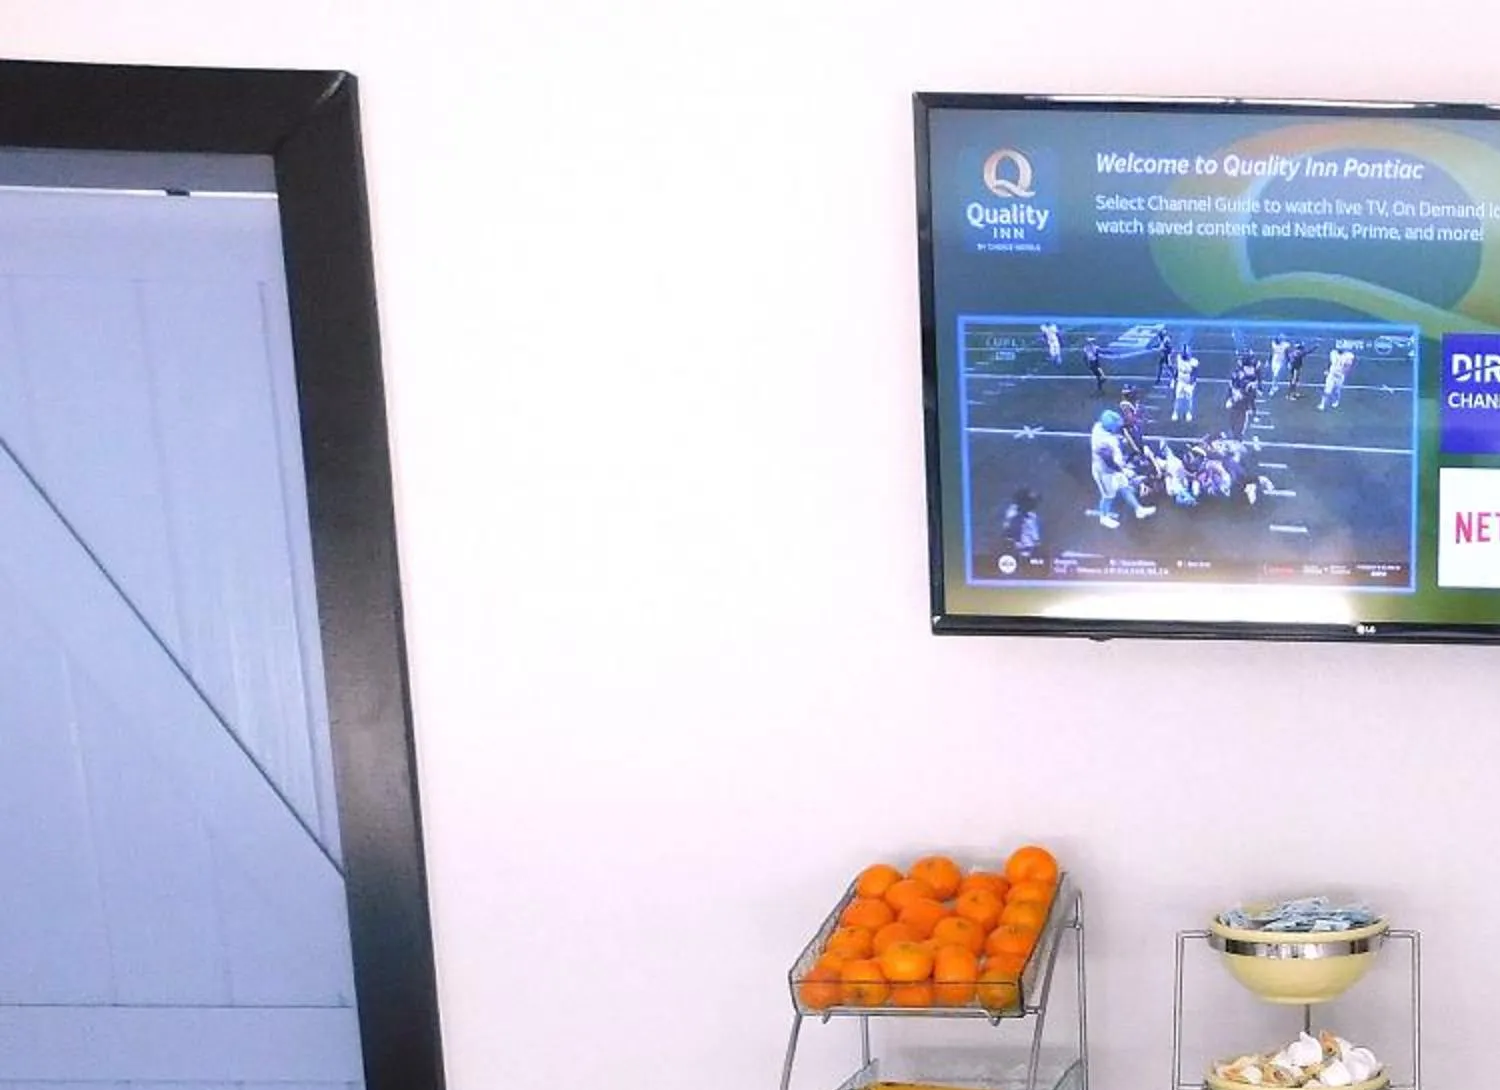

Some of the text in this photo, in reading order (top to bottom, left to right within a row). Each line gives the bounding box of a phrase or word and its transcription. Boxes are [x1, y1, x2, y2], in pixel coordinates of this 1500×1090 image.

[1096, 152, 1425, 182] Welcome to Quality Inn Pontiac
[966, 202, 1049, 230] Quality
[1095, 194, 1145, 212] Select
[1147, 195, 1211, 212] Channel
[1215, 196, 1261, 213] Guide
[1264, 199, 1281, 214] to
[1285, 198, 1332, 215] watch
[1335, 199, 1362, 215] live
[1366, 200, 1389, 218] TV,
[1393, 201, 1415, 217] On
[1419, 201, 1485, 218] Demand
[993, 227, 1025, 239] INN
[1095, 218, 1485, 242] watch saved content and Netflix, Prime, and more!
